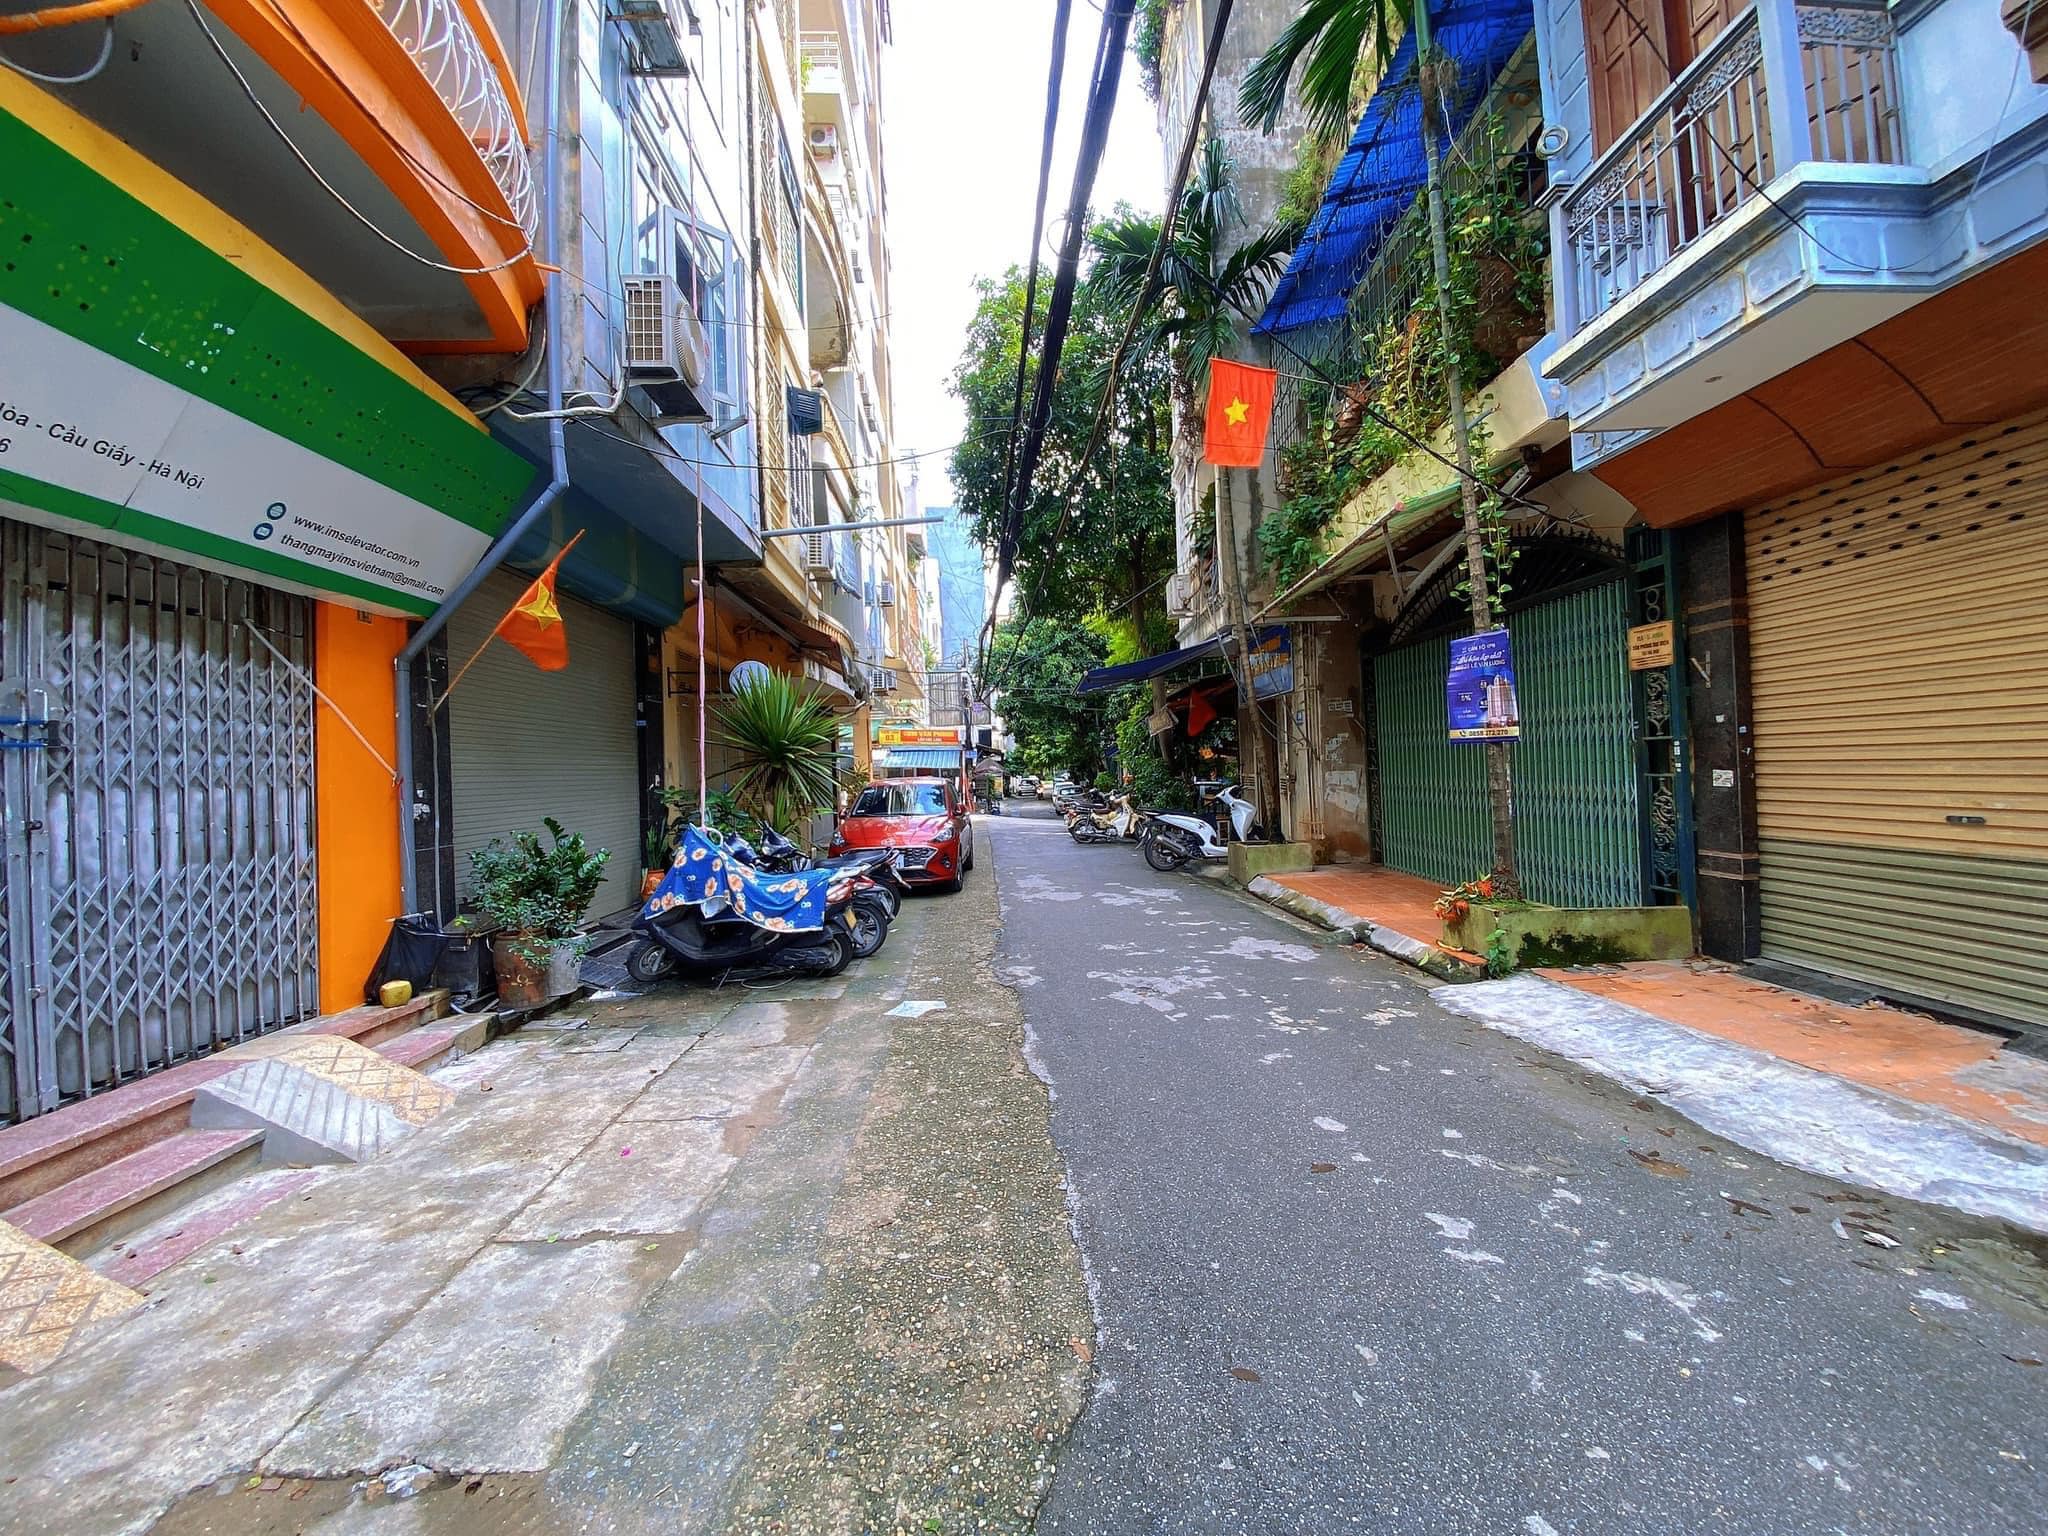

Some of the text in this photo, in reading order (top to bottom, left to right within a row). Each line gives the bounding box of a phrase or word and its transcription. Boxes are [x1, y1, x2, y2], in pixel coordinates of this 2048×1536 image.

[48, 424, 89, 448] Cầu
[93, 440, 136, 467] Giấy
[148, 459, 172, 478] Hà
[174, 469, 206, 490] Nội
[280, 533, 445, 596] thangmayimsvietnam@gmail.com
[293, 514, 421, 569] www.imselevator.com.vn
